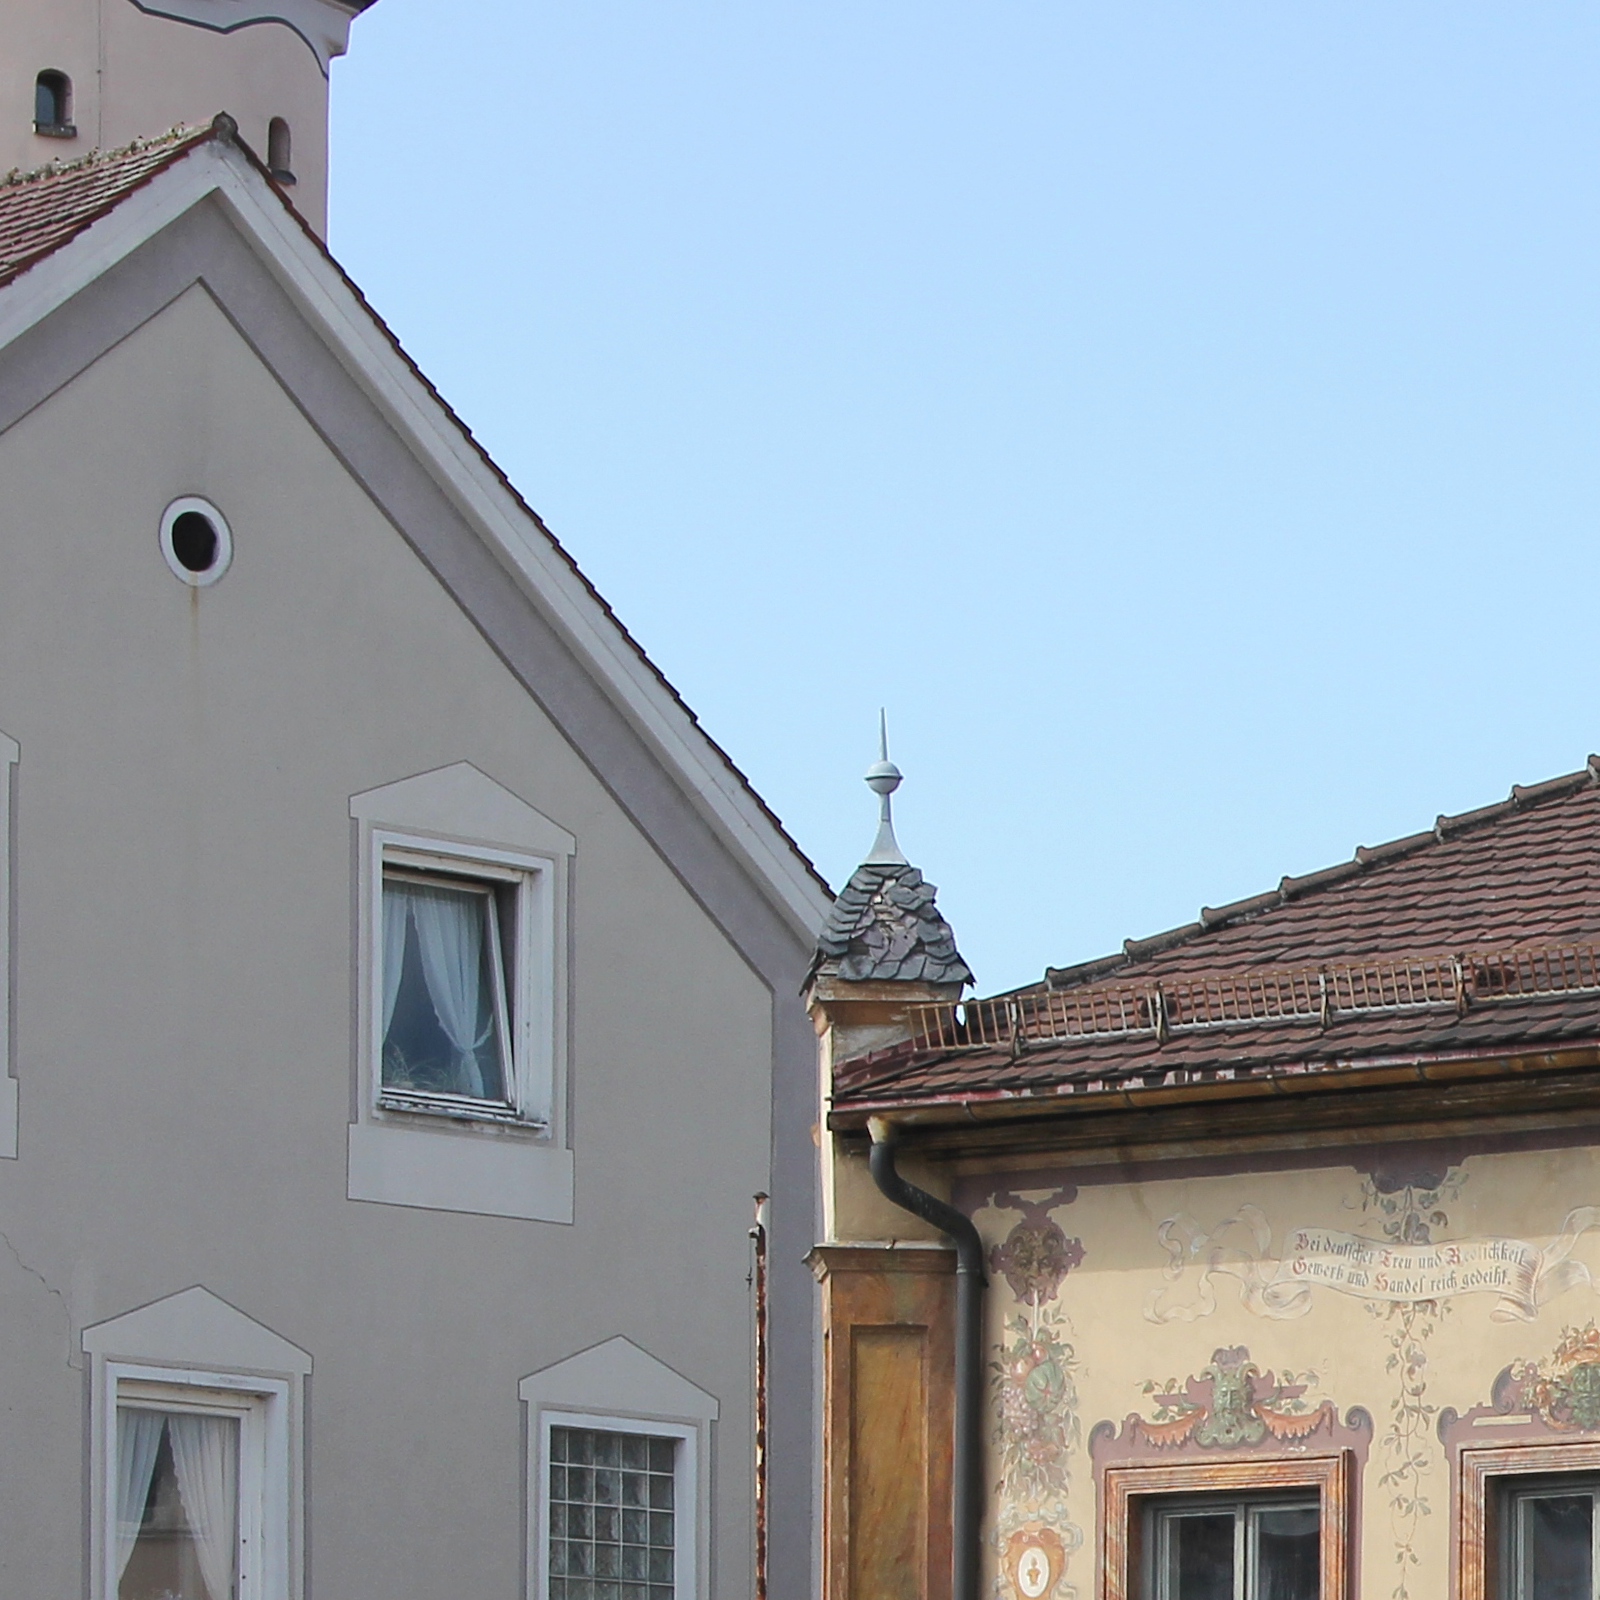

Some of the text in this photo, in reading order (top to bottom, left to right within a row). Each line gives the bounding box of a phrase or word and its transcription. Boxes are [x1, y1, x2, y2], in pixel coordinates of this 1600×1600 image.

[1294, 1233, 1321, 1251] Bei
[1379, 1249, 1412, 1269] Treu
[1418, 1251, 1442, 1269] und
[1347, 1270, 1369, 1288] und
[1374, 1272, 1426, 1294] Handel
[1430, 1270, 1458, 1292] reich
[1460, 1266, 1511, 1290] gedeiht.
